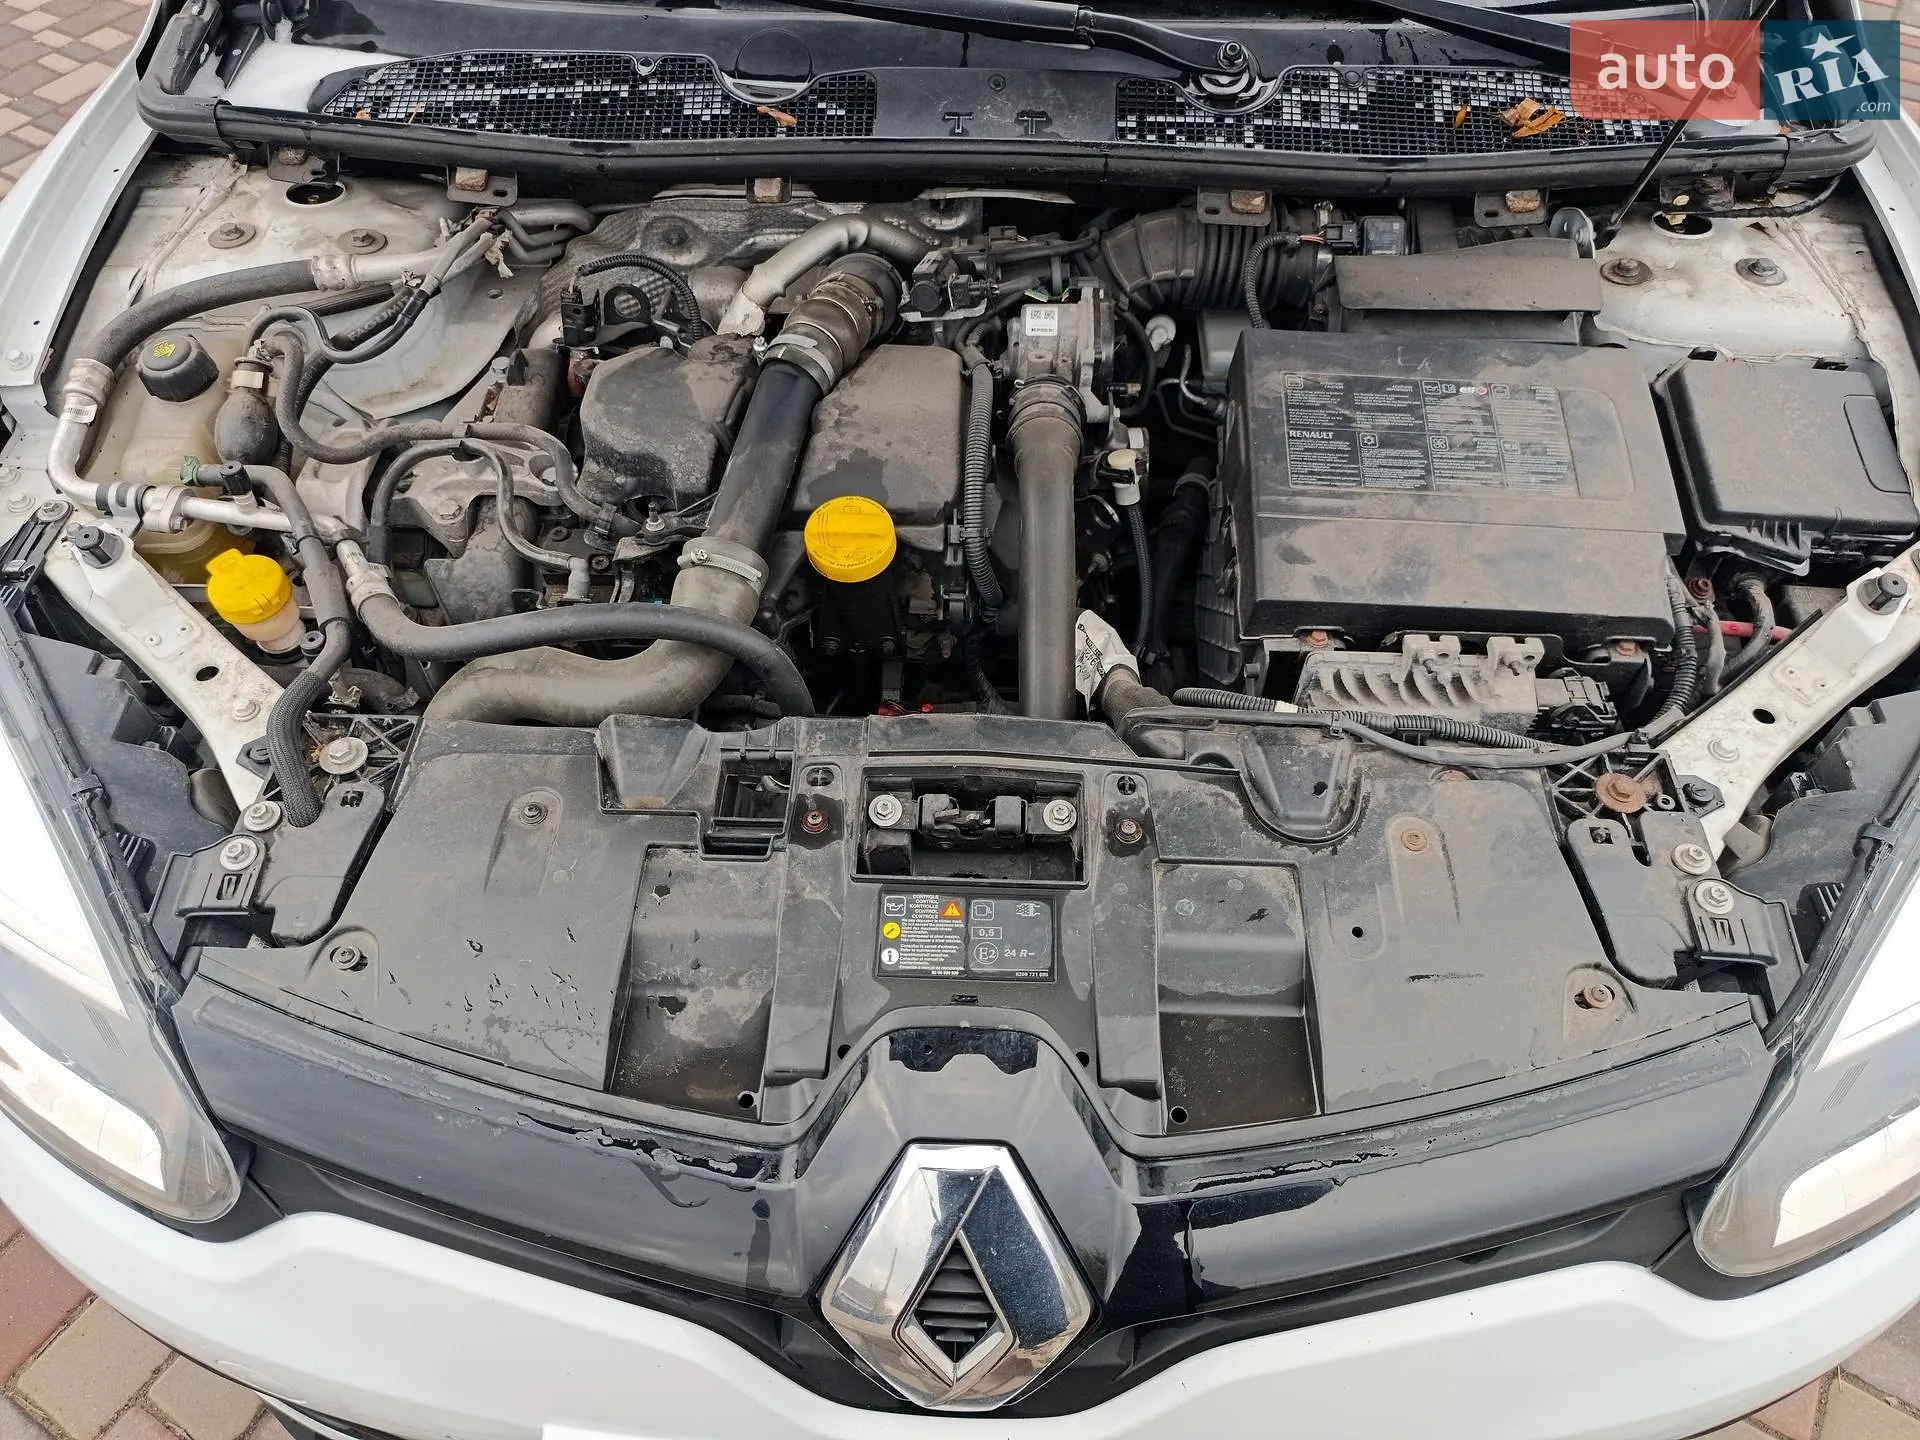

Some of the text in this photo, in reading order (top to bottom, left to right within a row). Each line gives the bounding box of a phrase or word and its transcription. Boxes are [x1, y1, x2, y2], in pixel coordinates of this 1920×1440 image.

[1289, 430, 1334, 440] RENAULT
[979, 928, 995, 937] 0,5
[978, 947, 996, 960] E2
[1004, 949, 1016, 957] 24
